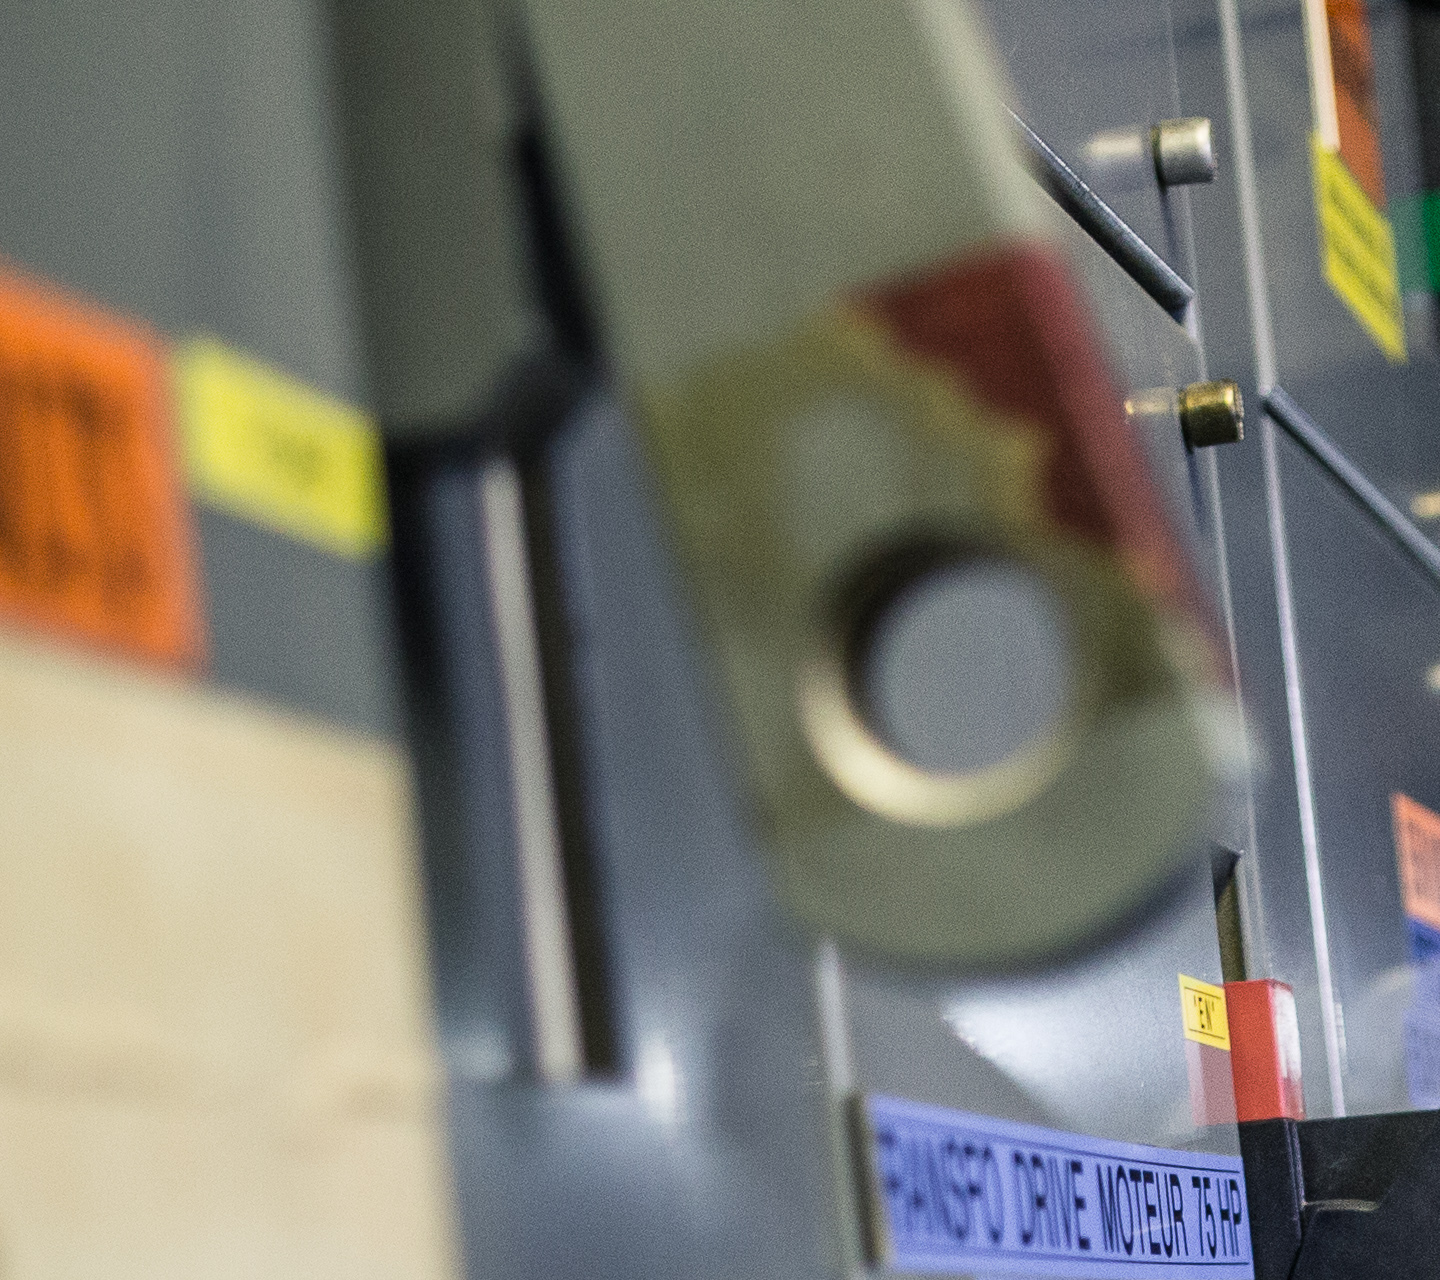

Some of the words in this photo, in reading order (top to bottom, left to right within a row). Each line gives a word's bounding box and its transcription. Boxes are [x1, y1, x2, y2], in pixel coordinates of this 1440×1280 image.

[1013, 1152, 1091, 1250] DRIVE
[1097, 1164, 1189, 1258] MOTEUR
[1192, 1176, 1217, 1259] 75
[1217, 1178, 1243, 1257] HP
